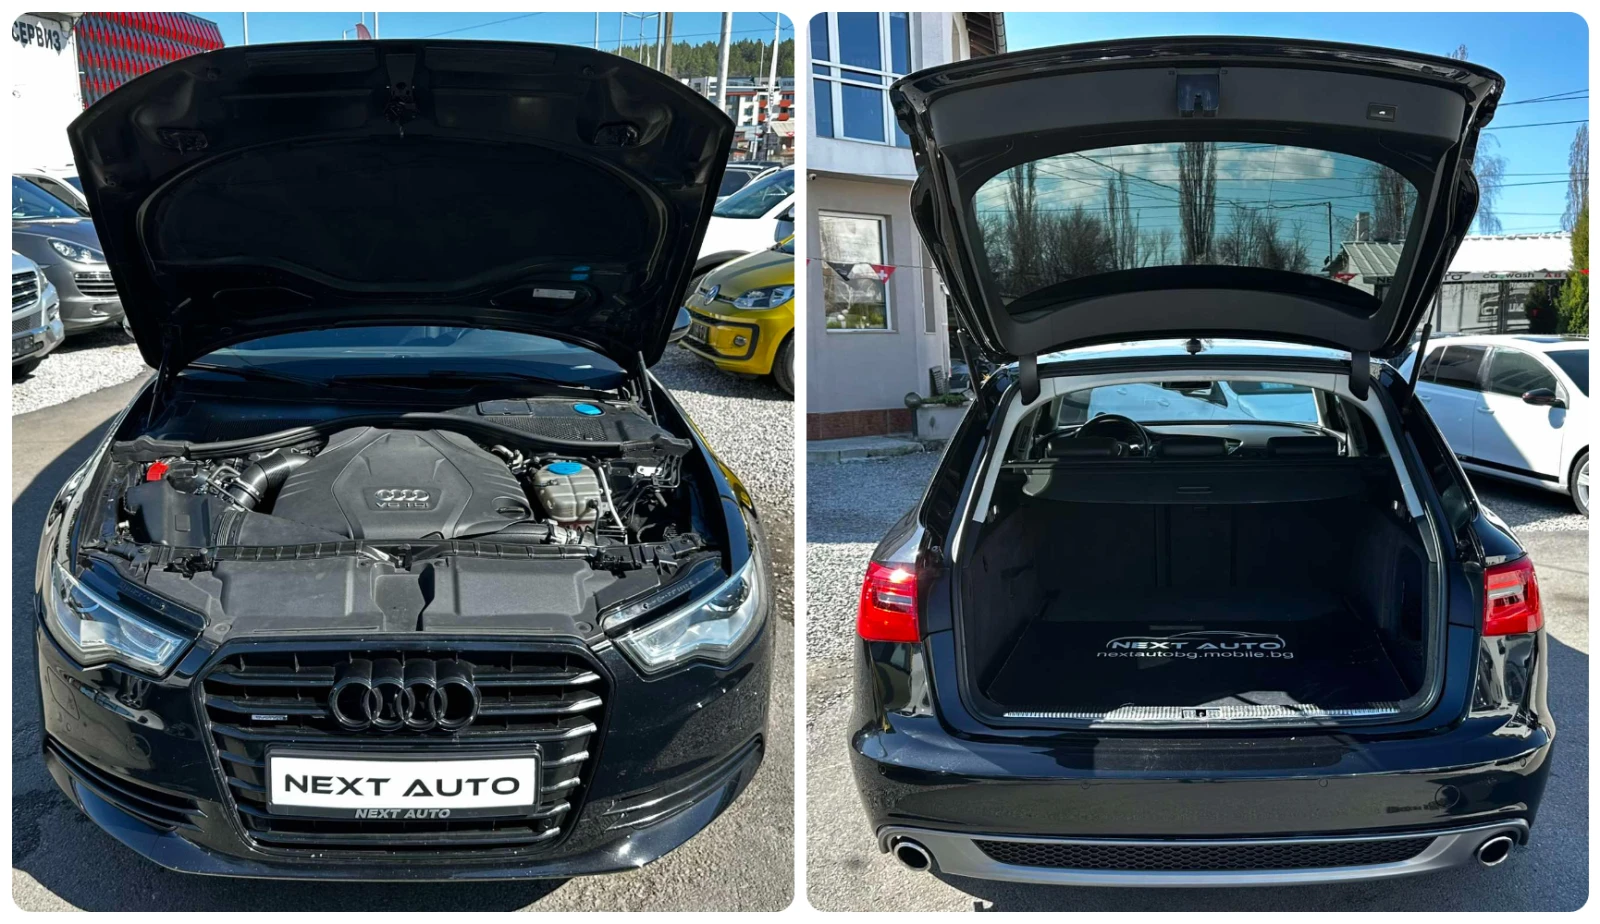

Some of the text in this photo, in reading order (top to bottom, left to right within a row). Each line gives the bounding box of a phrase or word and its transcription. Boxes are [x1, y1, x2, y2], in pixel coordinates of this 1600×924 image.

[12, 21, 61, 51] СЕРВИЗ
[1111, 641, 1281, 650] NEXT AUTO
[1096, 650, 1294, 659] nextautobg.mobile.bg
[284, 774, 520, 797] NEXT AUTO
[355, 808, 451, 819] NEXT AUTO
